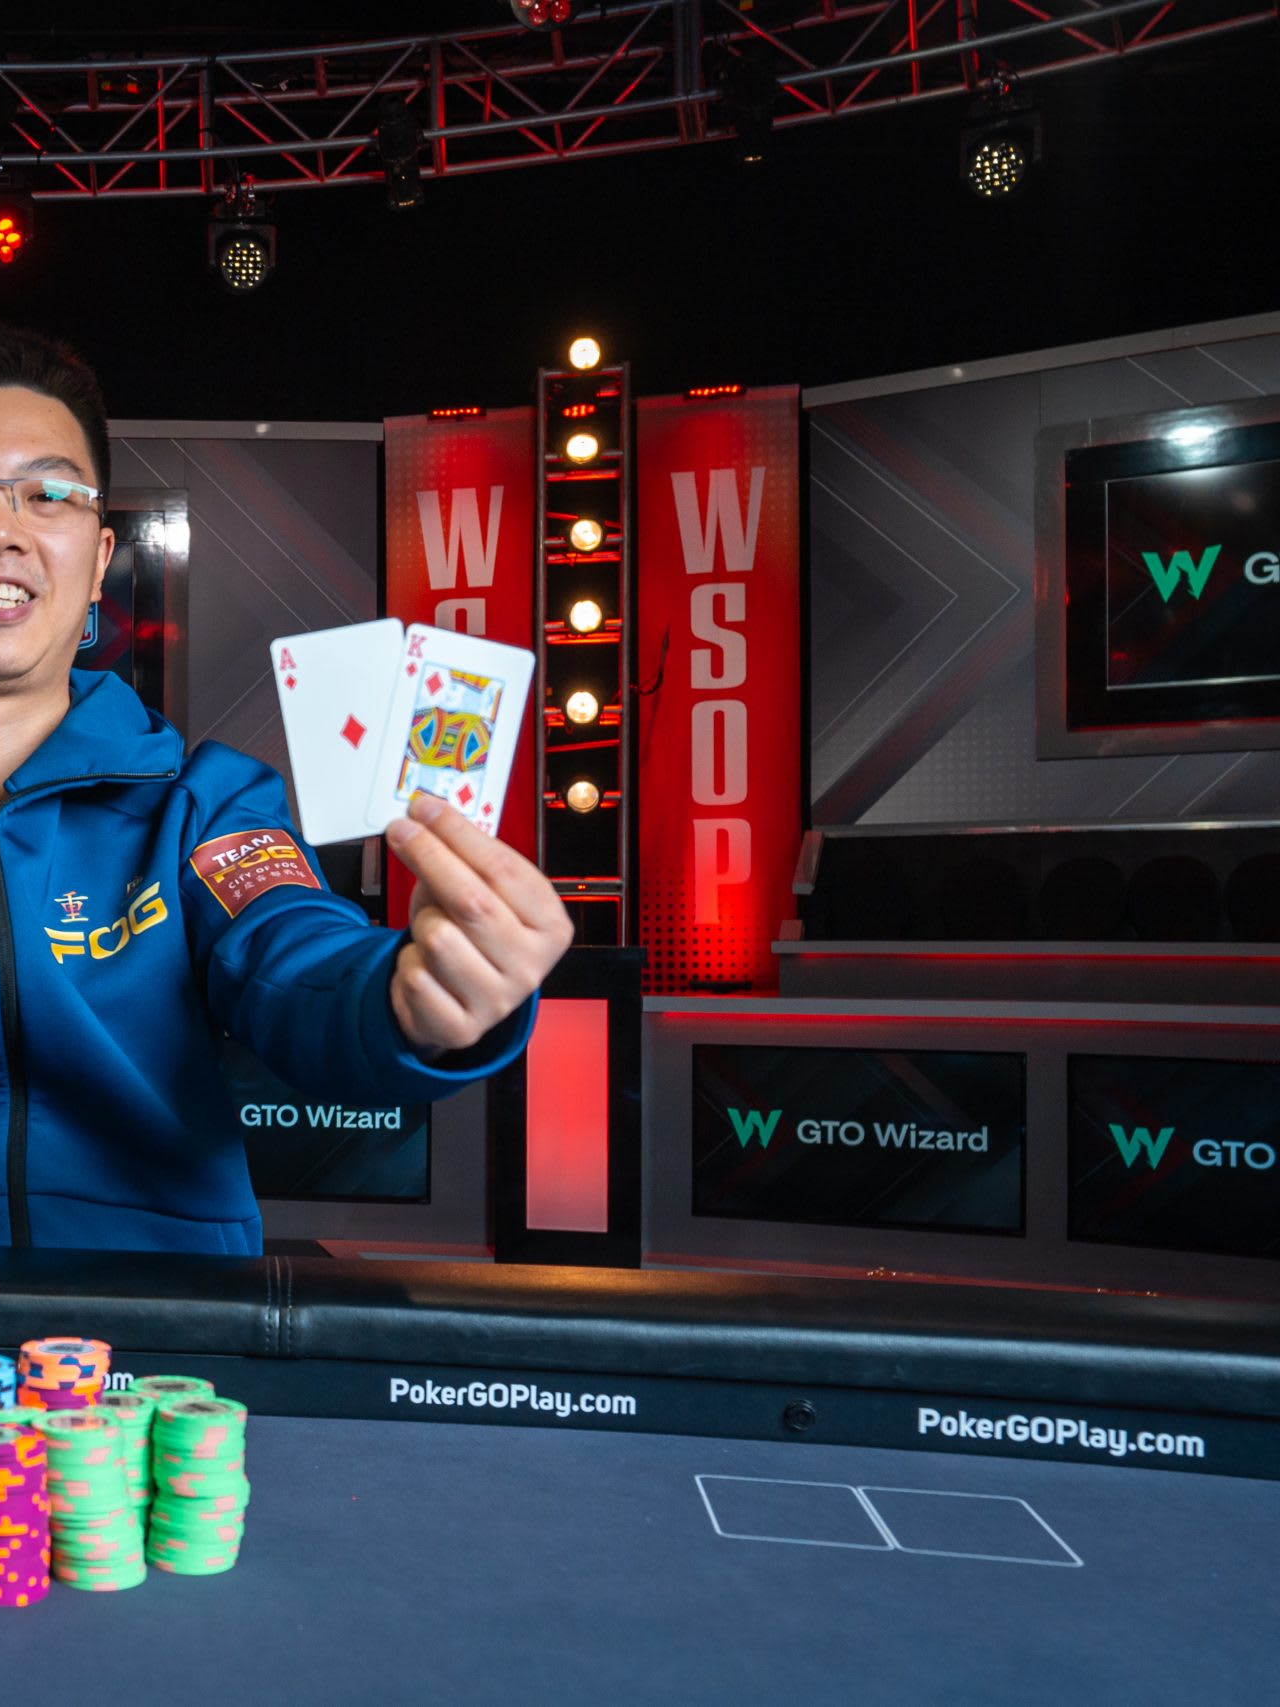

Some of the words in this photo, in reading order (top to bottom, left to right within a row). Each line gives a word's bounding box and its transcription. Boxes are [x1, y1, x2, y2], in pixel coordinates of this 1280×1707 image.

[279, 647, 297, 671] A
[671, 466, 766, 925] WSOP
[211, 834, 275, 868] TEAM
[228, 871, 252, 889] CITY
[255, 864, 271, 874] OF
[274, 861, 298, 870] FOG
[43, 881, 168, 965] FOG
[239, 1103, 299, 1128] GTO
[305, 1104, 401, 1130] Wizard
[796, 1119, 866, 1146] GTO
[873, 1122, 989, 1153] Wizard
[1192, 1138, 1276, 1170] GTO
[389, 1377, 637, 1418] PokerGOPlay.com
[917, 1406, 1206, 1458] PokerGOPlay.com
